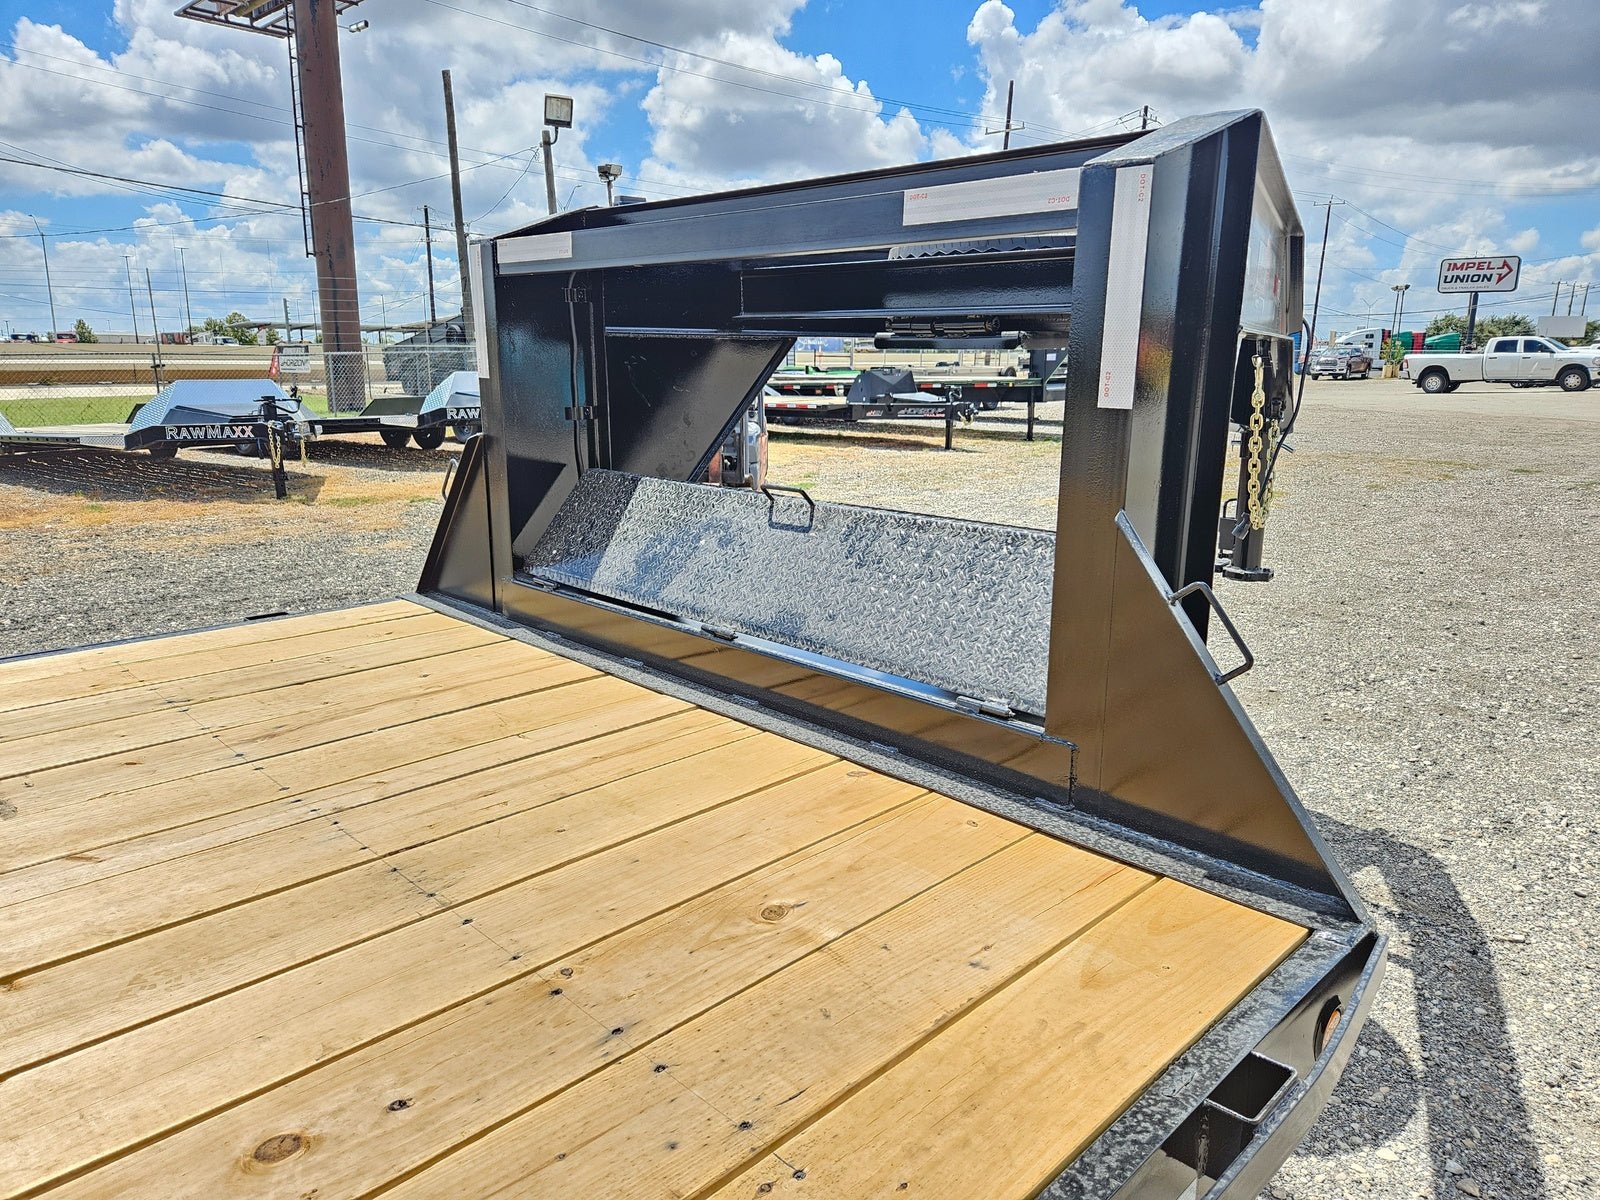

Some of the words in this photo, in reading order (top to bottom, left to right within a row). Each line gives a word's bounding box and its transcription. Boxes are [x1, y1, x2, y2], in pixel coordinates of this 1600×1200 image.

[1138, 173, 1146, 202] DOT-C2
[1446, 261, 1496, 272] IMPEL
[1443, 273, 1493, 284] UNION
[164, 424, 255, 440] RAWMAXX
